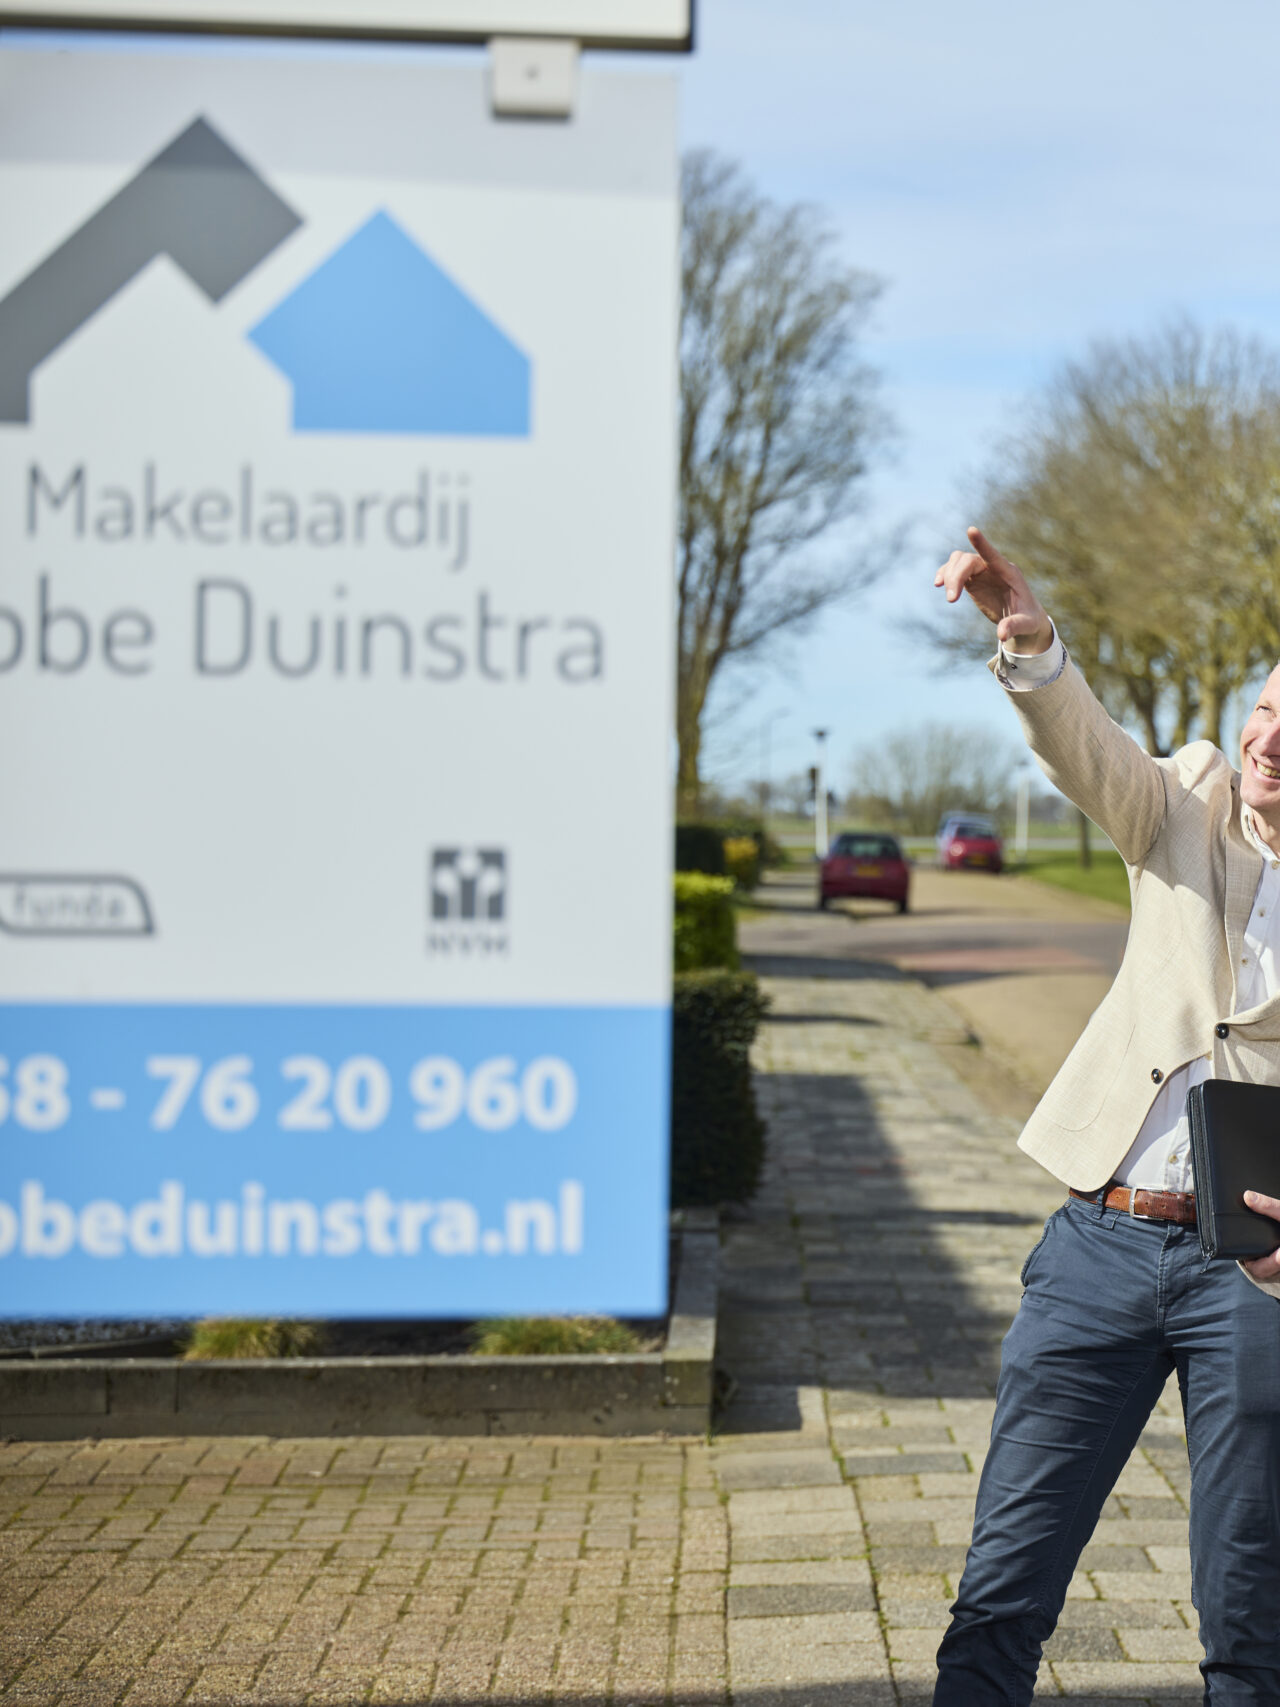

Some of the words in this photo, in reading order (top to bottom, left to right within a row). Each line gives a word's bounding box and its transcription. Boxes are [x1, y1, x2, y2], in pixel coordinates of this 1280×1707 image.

[24, 459, 470, 572] Makelaardij
[192, 576, 605, 683] Duinstra
[12, 883, 126, 922] funda
[0, 1054, 70, 1131] 8
[89, 1087, 126, 1111] -
[146, 1055, 259, 1131] 76
[278, 1056, 391, 1131] 20
[409, 1056, 578, 1131] 960
